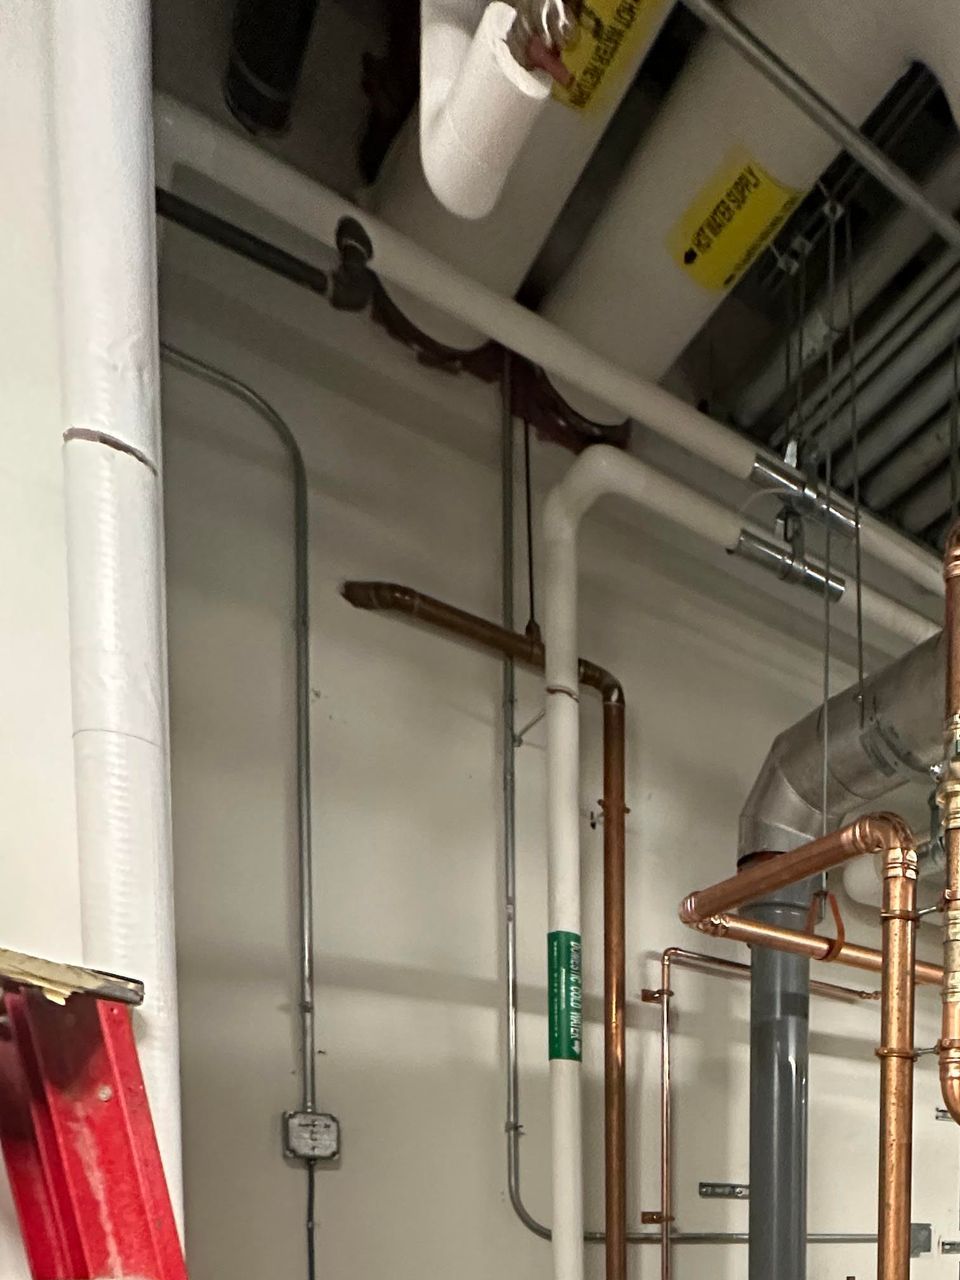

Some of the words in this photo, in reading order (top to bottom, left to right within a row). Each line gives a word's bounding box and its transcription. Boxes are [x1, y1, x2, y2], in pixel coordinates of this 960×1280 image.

[691, 225, 714, 255] HOT
[705, 199, 735, 238] WATER
[725, 165, 761, 211] SUPPLY
[570, 941, 582, 983] DOMESTIC
[570, 986, 582, 1010] COLD
[570, 1012, 583, 1039] WATER
